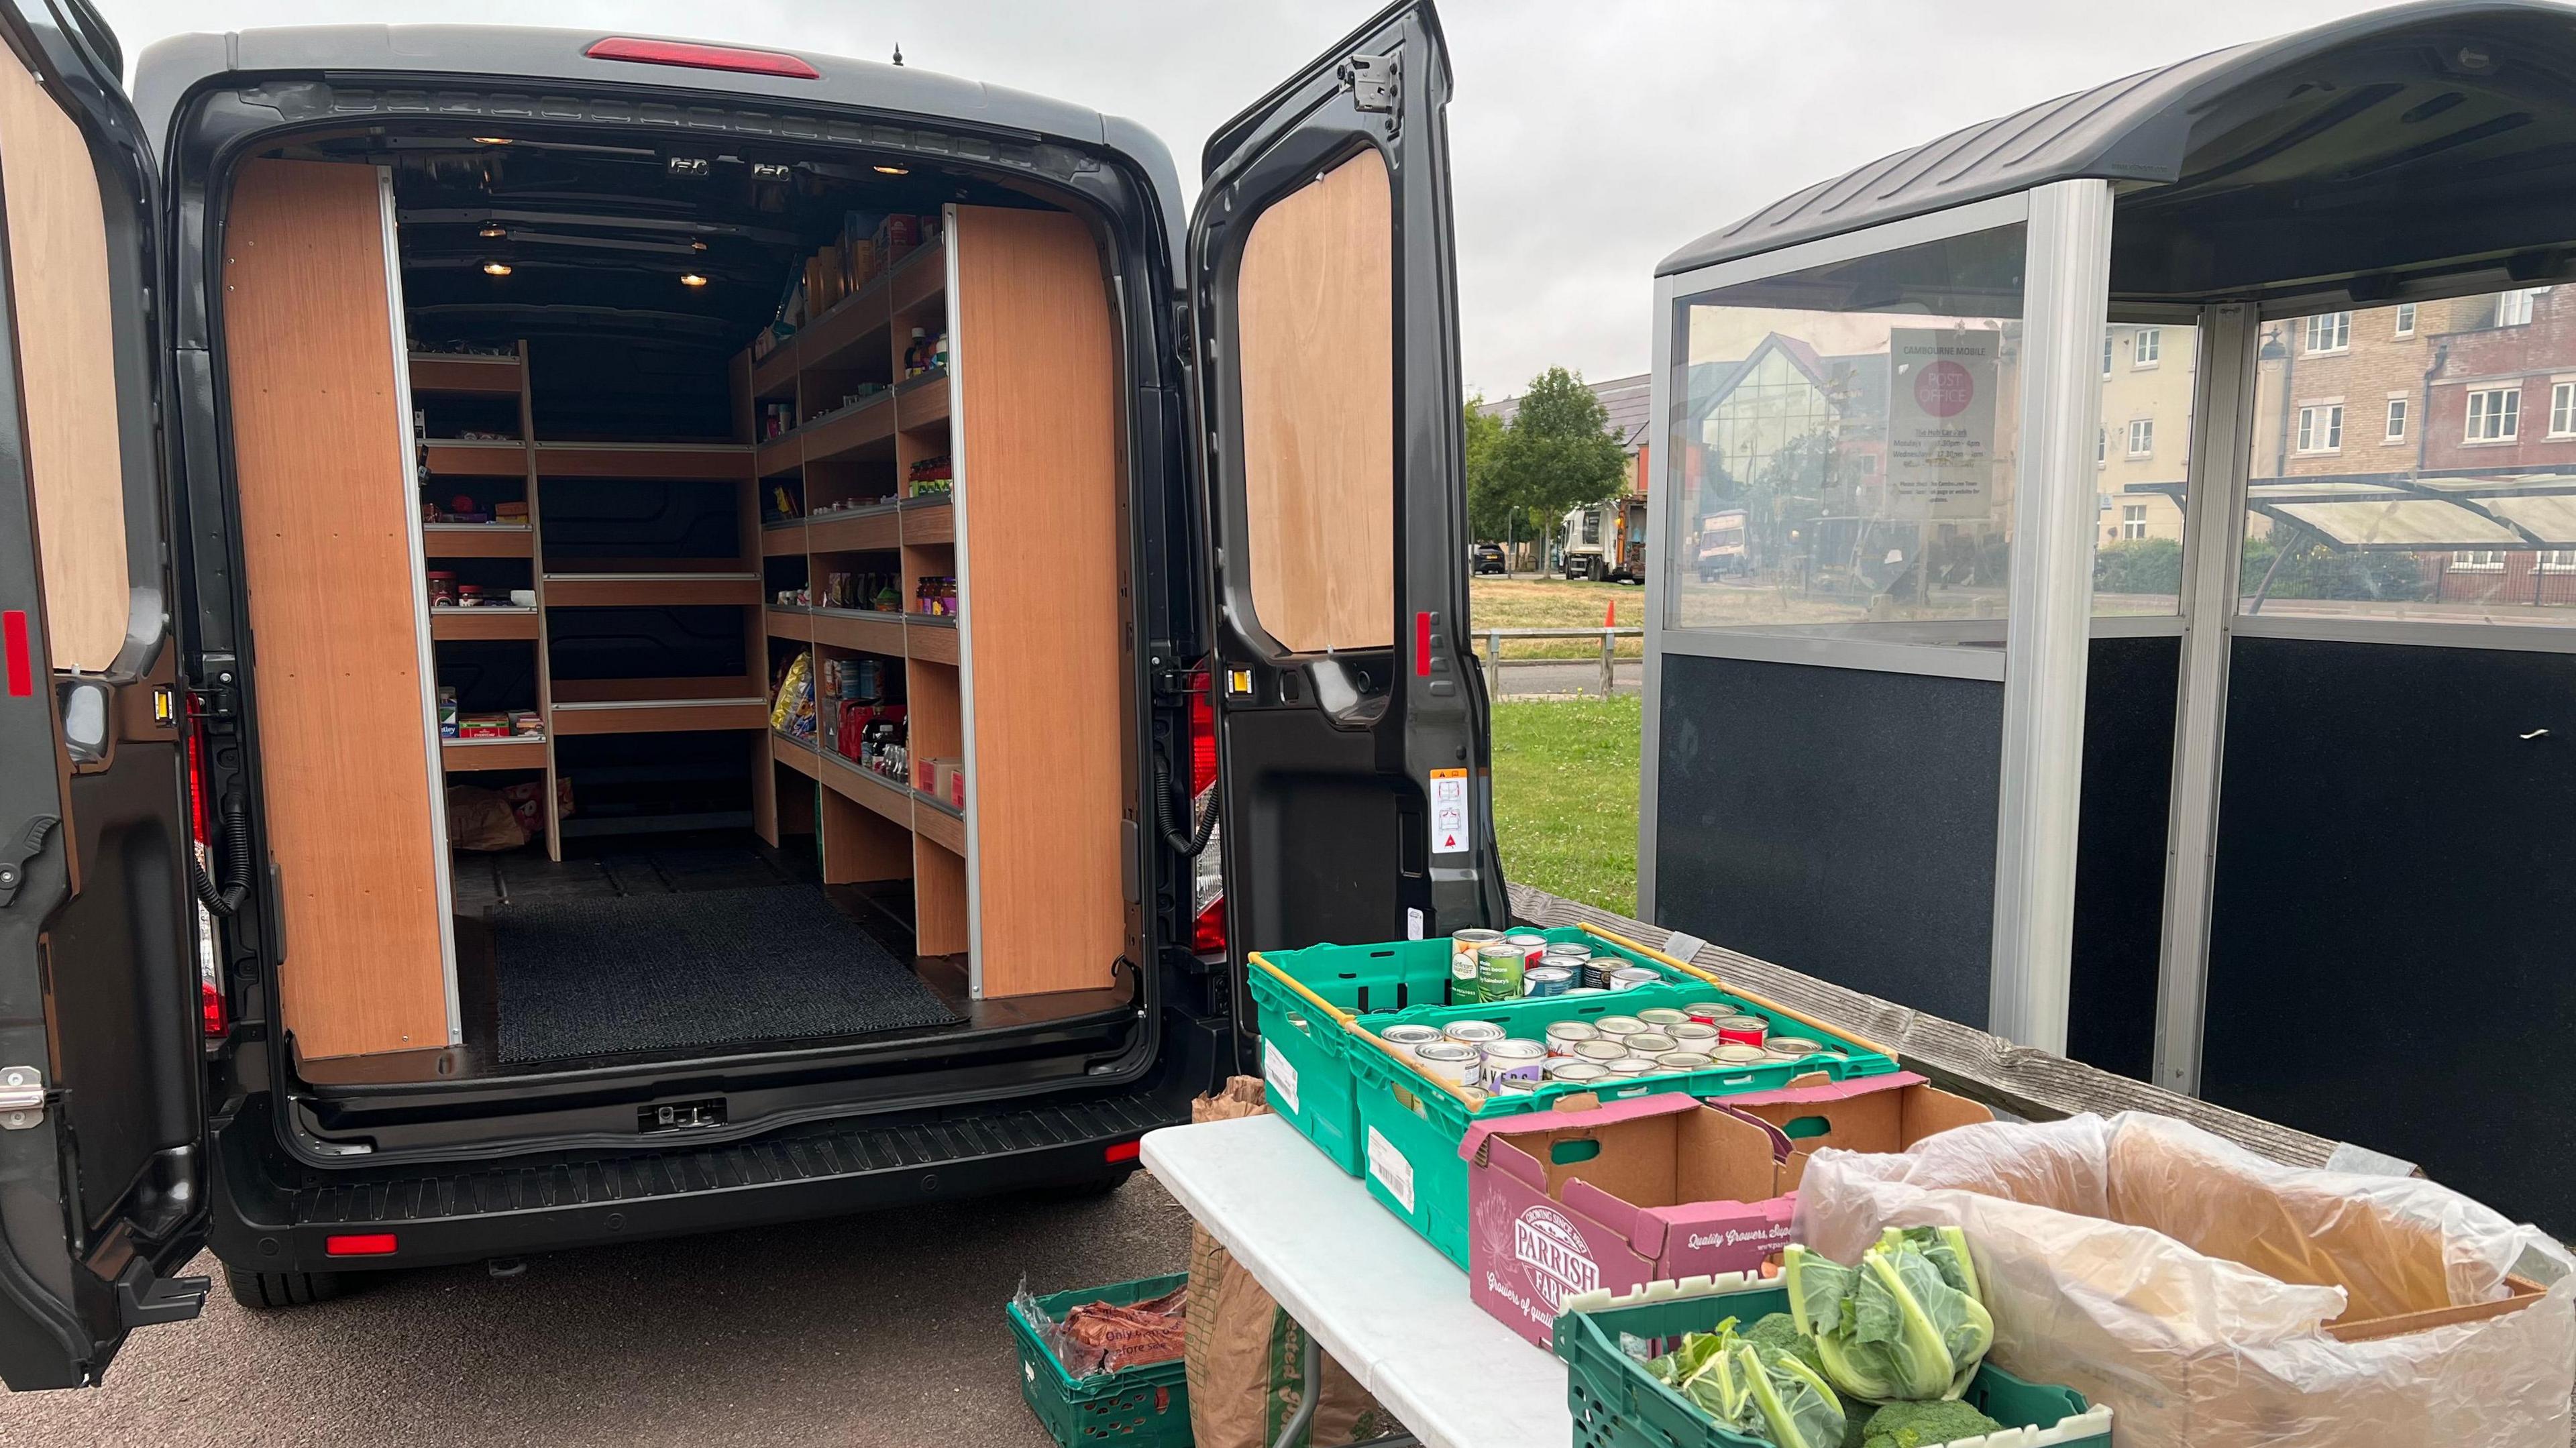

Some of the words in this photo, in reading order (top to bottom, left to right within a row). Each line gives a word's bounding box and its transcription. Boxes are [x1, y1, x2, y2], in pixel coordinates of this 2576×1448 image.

[1904, 346, 1954, 355] CAMBOURNE
[1956, 347, 1986, 356] MOBILE
[1928, 372, 1963, 386] POST
[1920, 389, 1966, 402] OFFICE
[1526, 1209, 1553, 1223] GROWING
[1552, 1213, 1573, 1236] SINCE
[1688, 1233, 1723, 1249] Quality
[1725, 1229, 1768, 1246] Growers,
[1518, 1224, 1597, 1293] PARRISH
[1487, 1271, 1519, 1306] Growers
[1520, 1297, 1530, 1316] of
[1536, 1270, 1574, 1307] FAR
[1106, 1329, 1132, 1342] Only
[1146, 1342, 1166, 1350] sale
